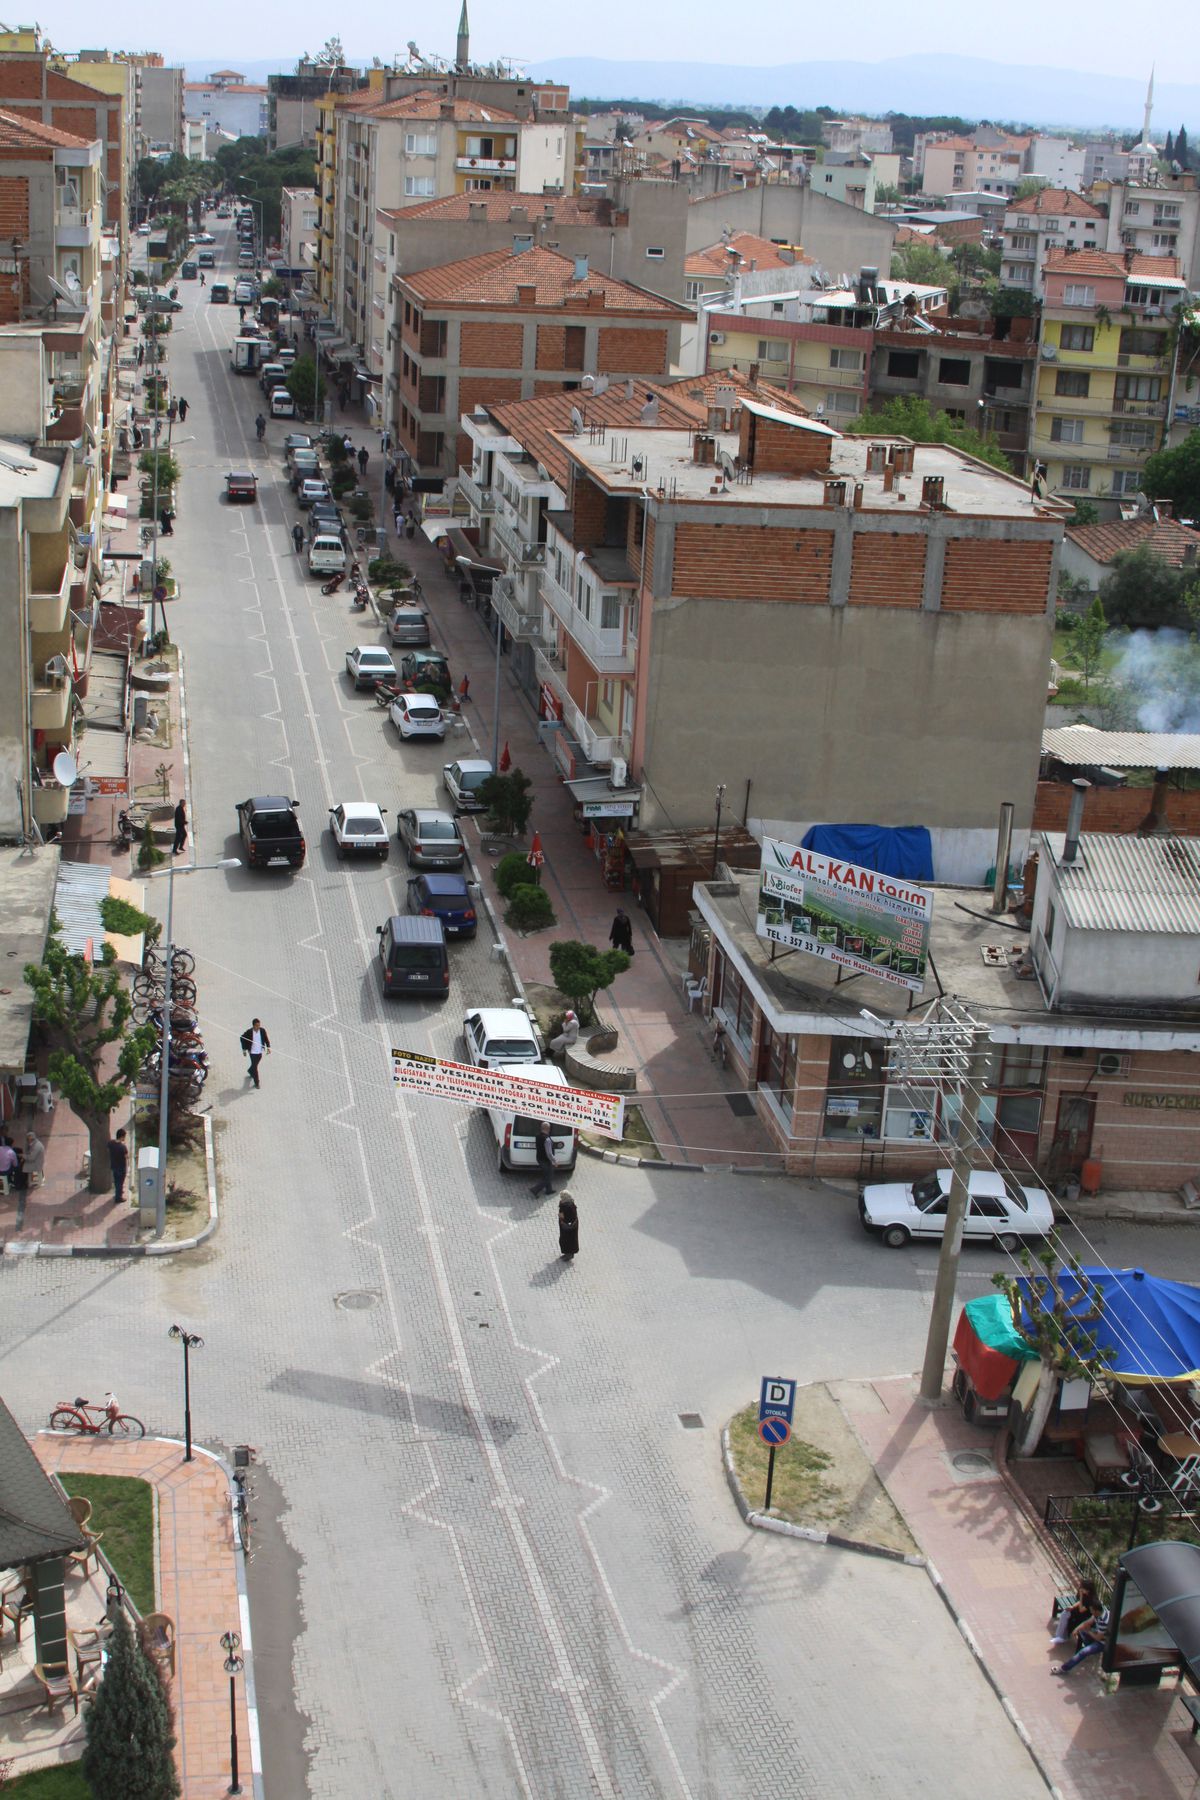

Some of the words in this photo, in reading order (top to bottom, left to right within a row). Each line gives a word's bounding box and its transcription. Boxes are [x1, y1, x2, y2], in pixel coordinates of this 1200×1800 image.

[775, 879, 802, 895] Biofer
[791, 851, 874, 893] AL-KAN
[878, 879, 926, 908] tarım
[797, 871, 830, 886] tarımsal
[832, 881, 880, 904] danışmanlık
[883, 897, 926, 918] hizmetleri
[766, 928, 781, 941] TEL
[789, 936, 803, 947] 357
[805, 941, 814, 951] 33
[816, 945, 826, 956] 77
[830, 952, 852, 966] Devlet
[852, 959, 885, 978] Hastanesi
[885, 972, 908, 987] Karşısı
[393, 1050, 412, 1060] FOTO
[407, 1062, 437, 1072] ADET
[441, 1068, 504, 1087] VESİKALIK
[547, 1090, 583, 1104] DEĞİL
[600, 1102, 612, 1111] TL
[547, 1106, 612, 1127] İNDİRİMLER
[770, 1385, 785, 1401] D
